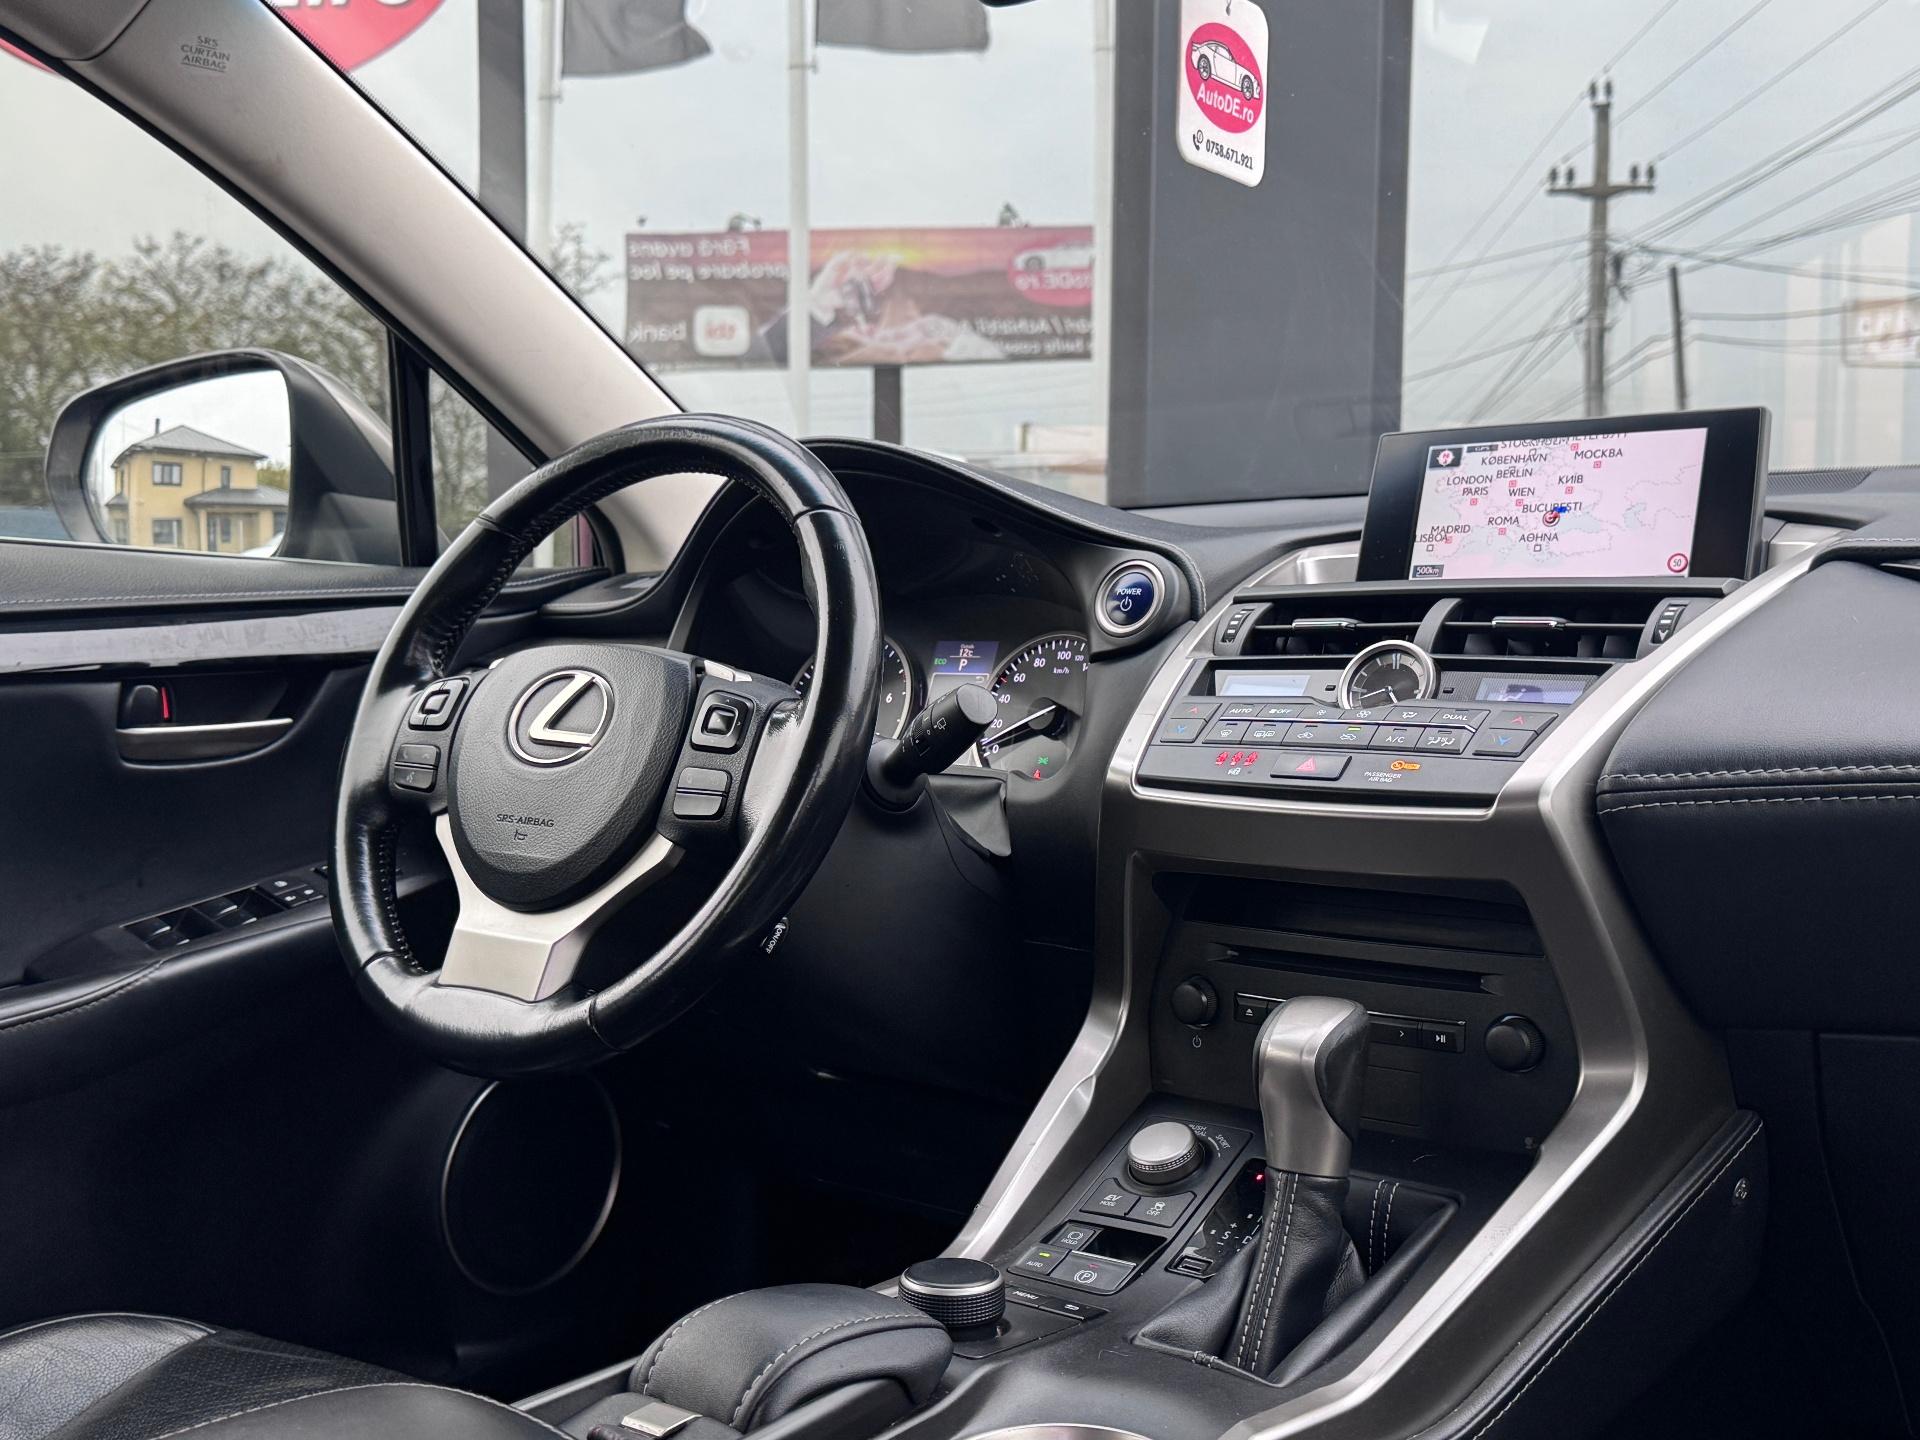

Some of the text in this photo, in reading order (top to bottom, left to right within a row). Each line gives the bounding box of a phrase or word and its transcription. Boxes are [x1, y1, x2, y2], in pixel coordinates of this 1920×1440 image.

[181, 44, 230, 61] CURTAIN
[183, 55, 227, 69] AIRBAG
[1197, 83, 1254, 124] AutoDE.ro
[1205, 139, 1254, 170] 0758.671.921
[1481, 453, 1548, 466] KØBENHAVN
[1496, 468, 1533, 479] BERLIN
[1446, 475, 1493, 486] LONDON
[1462, 487, 1489, 497] PARIS
[1508, 487, 1536, 497] WIEN
[1488, 516, 1520, 526] ROMA
[1430, 524, 1471, 535] MADRID
[1415, 533, 1448, 543] LISBOA
[1672, 558, 1682, 567] 50
[1416, 565, 1440, 576] 500km
[1116, 587, 1143, 596] POWER
[934, 657, 947, 665] ECO
[1057, 651, 1072, 661] 100
[958, 658, 968, 672] P
[1033, 657, 1046, 667] 80
[1053, 666, 1070, 674] km/h
[1013, 673, 1026, 683] 60
[885, 692, 893, 704] 6
[999, 694, 1011, 704] 40
[1442, 713, 1468, 721] DUAL
[991, 719, 1003, 729] 20
[1386, 735, 1405, 743] A/C
[992, 744, 999, 754] 0
[1364, 771, 1402, 779] PASSENGER
[496, 813, 555, 828] SRS-AIRBAG
[1215, 1134, 1231, 1149] SPORT
[1103, 1194, 1123, 1202] EV
[1026, 1260, 1044, 1268] AUTO
[1012, 1290, 1040, 1300] MENU
